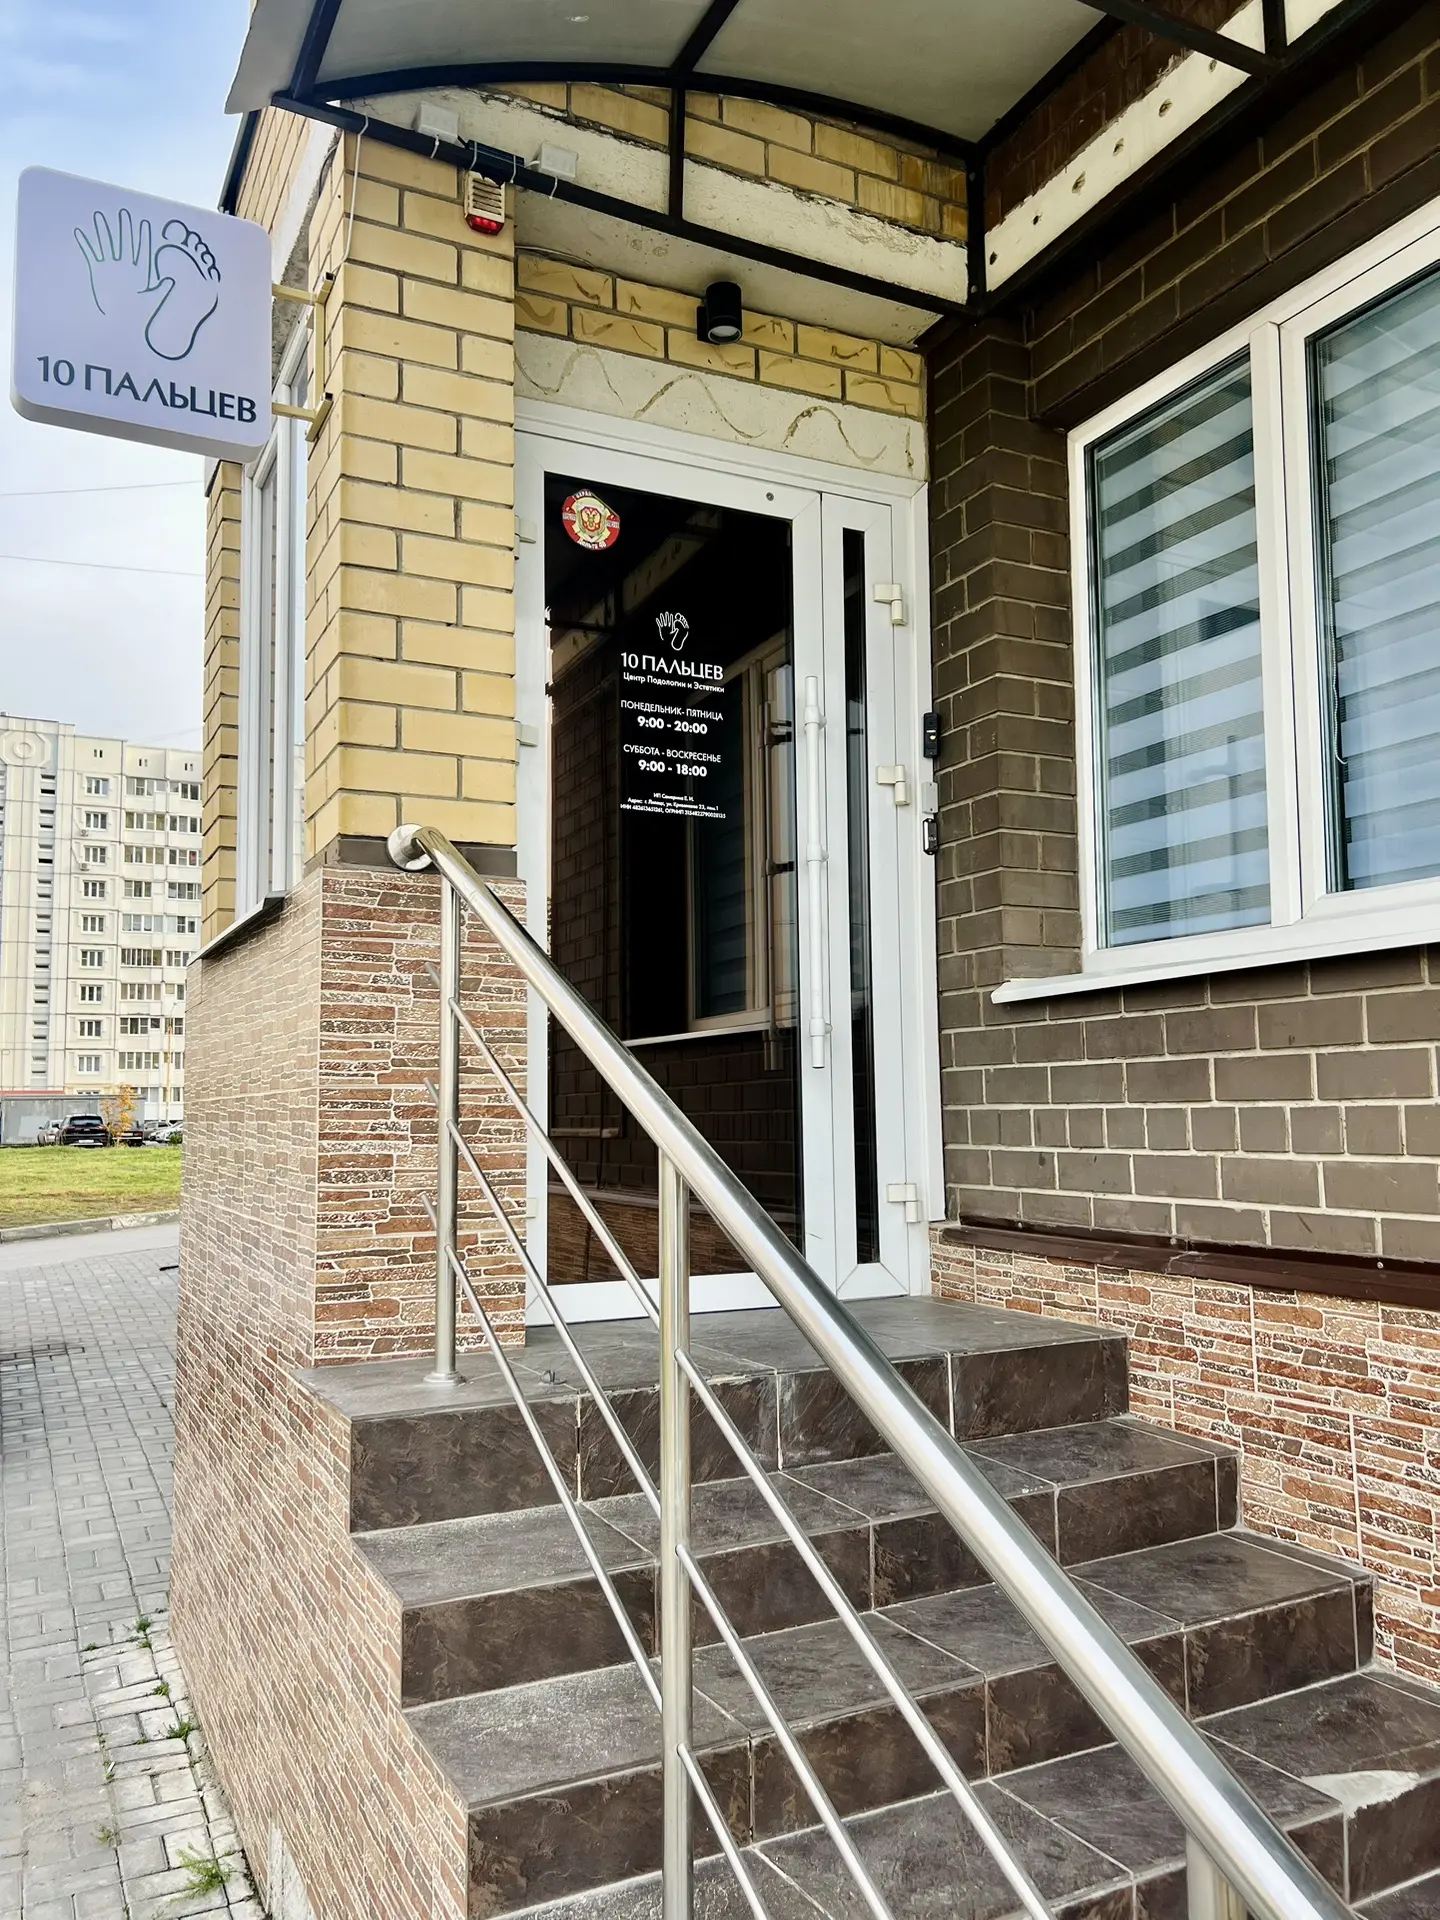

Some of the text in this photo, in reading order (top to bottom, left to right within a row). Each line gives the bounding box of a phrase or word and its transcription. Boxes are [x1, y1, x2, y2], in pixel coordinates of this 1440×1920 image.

[37, 355, 257, 423] 10 ПАЛЬЦЕВ
[621, 652, 723, 680] 10 ПАЛЬЦЕВ
[623, 672, 645, 684] Центр
[647, 675, 686, 688] Подологии
[694, 681, 725, 693] Эстетики
[686, 708, 723, 721] ПЯТНИЦА
[637, 715, 664, 729] 9:00
[674, 720, 708, 734] 20:00
[623, 744, 660, 756] СУББОТА
[666, 748, 721, 763] ВОСКРЕСЕНЬЕ
[638, 759, 665, 773] 9:00
[675, 763, 707, 777] 18:00
